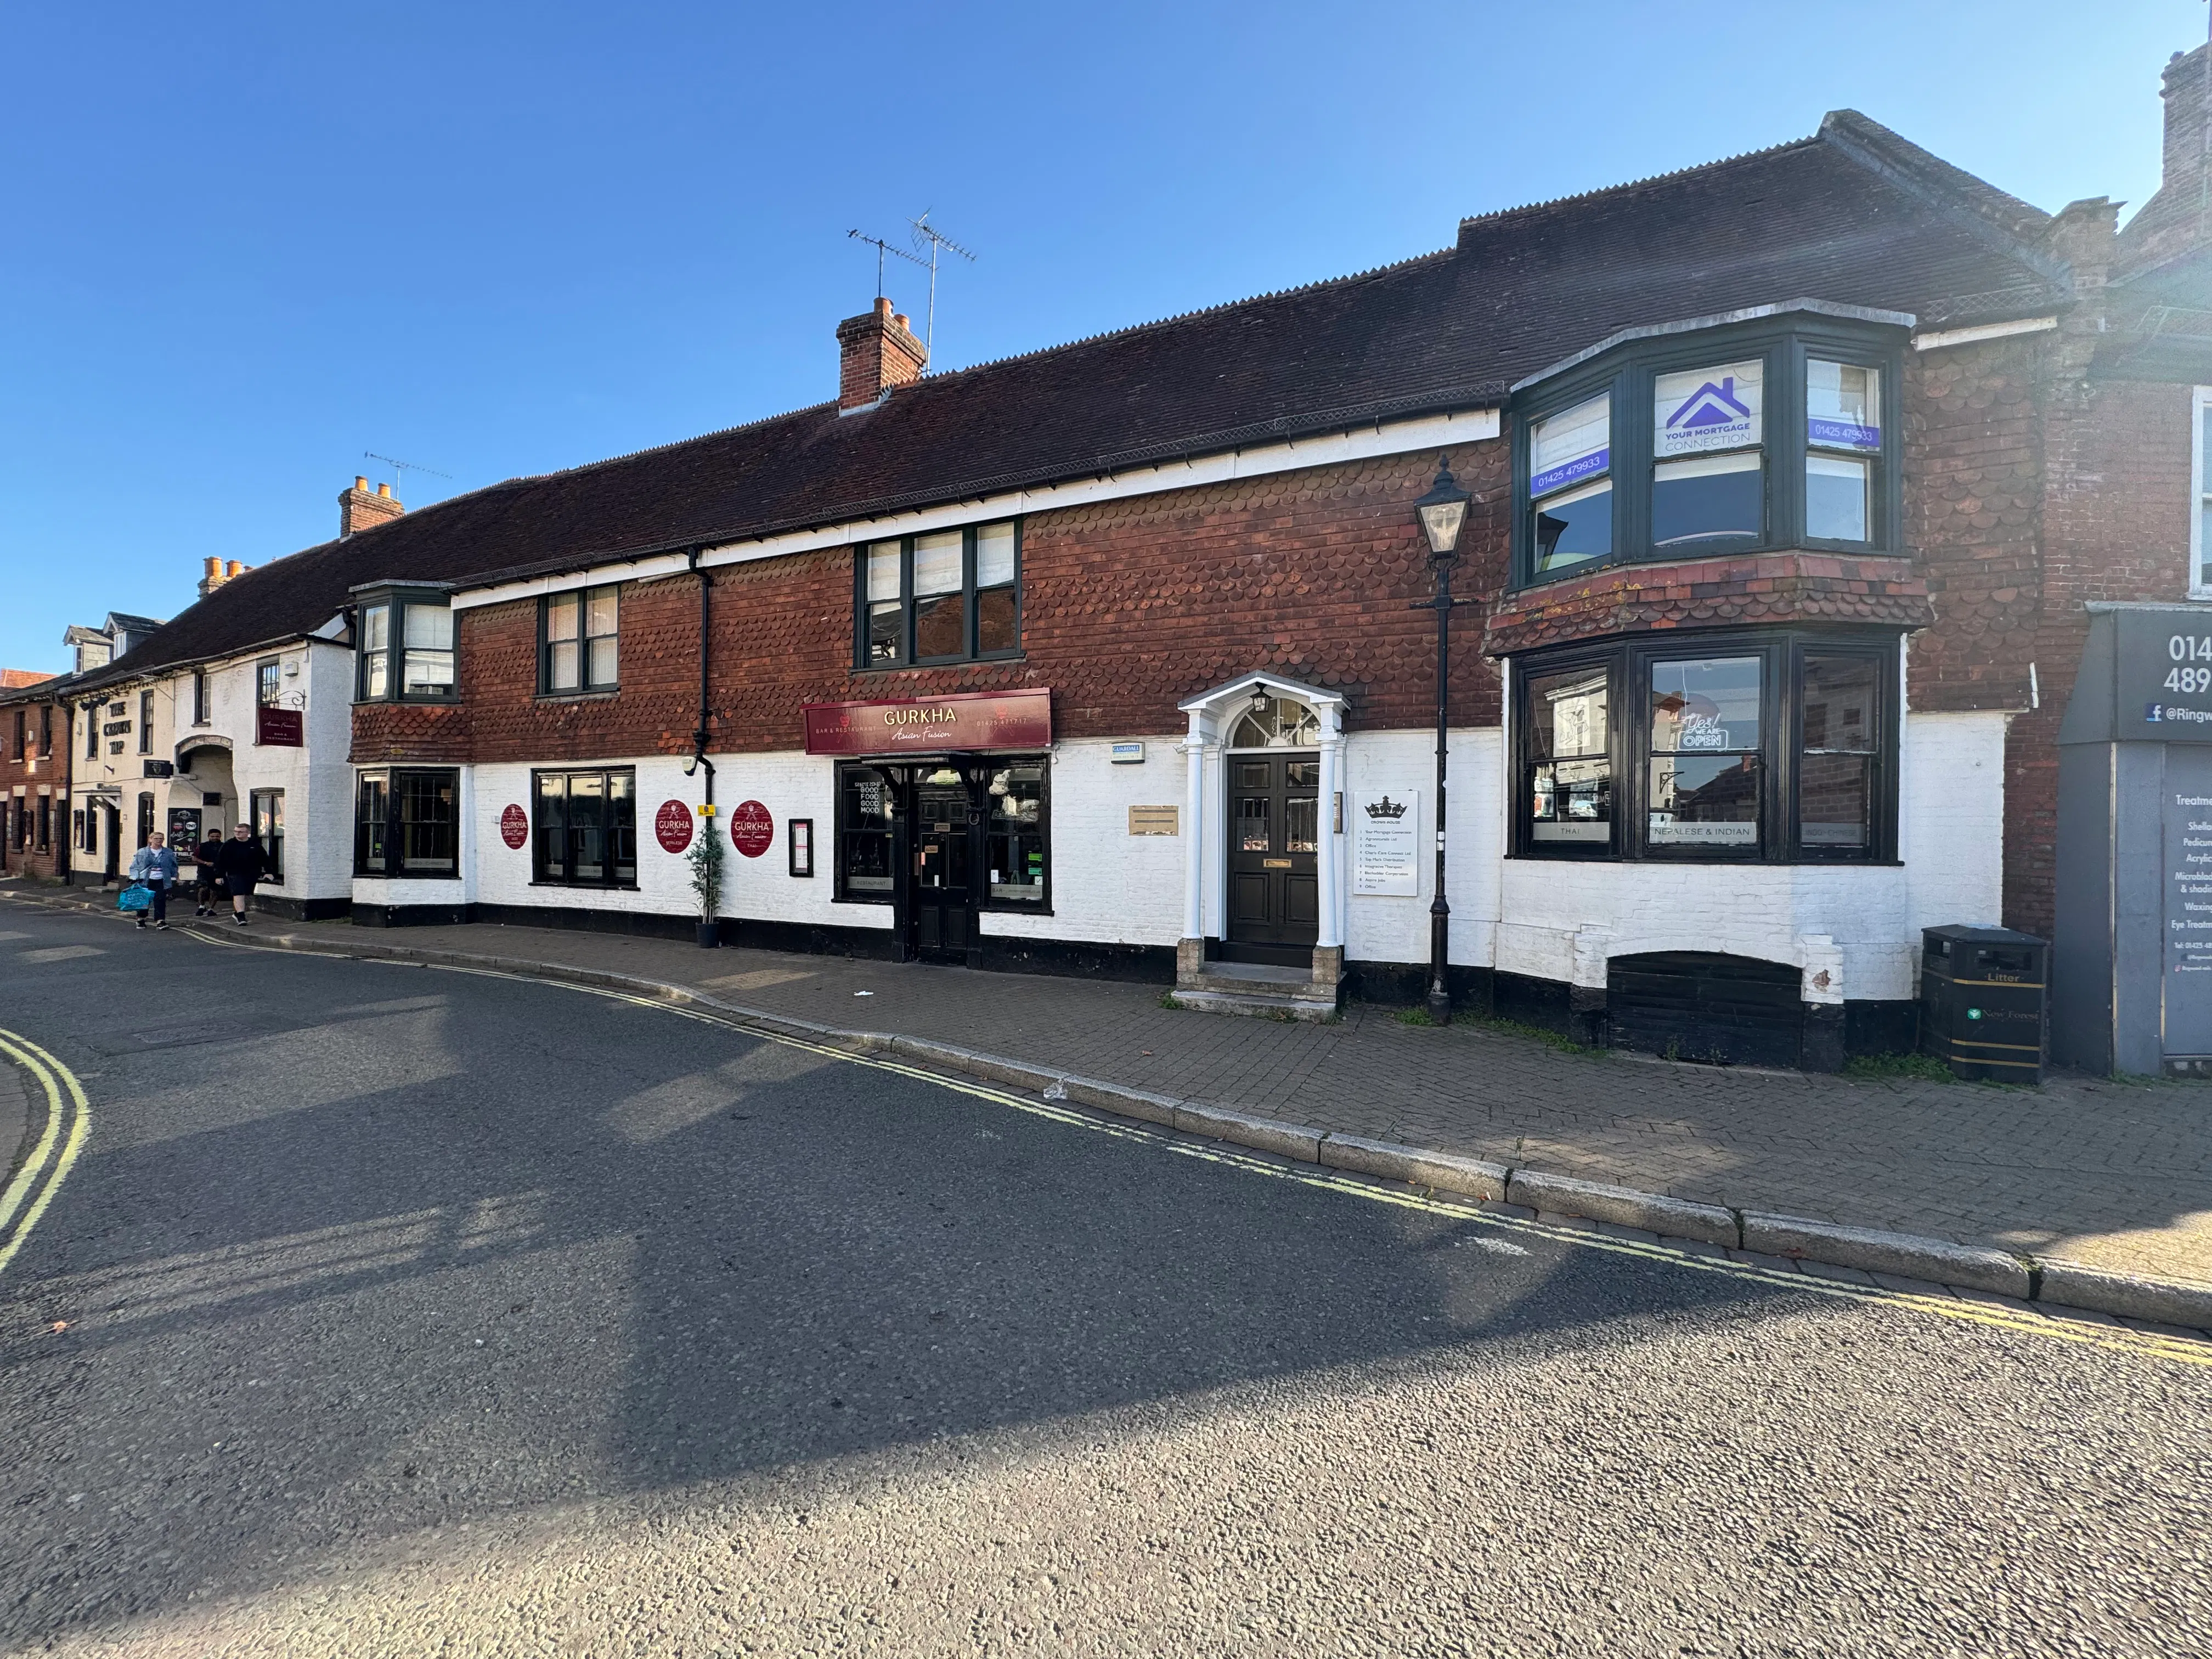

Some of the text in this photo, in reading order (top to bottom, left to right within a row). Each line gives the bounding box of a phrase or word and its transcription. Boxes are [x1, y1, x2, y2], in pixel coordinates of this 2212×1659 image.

[1666, 422, 1750, 440] YOUR MORTGAGE
[1815, 425, 1872, 441] 01425 479933
[1665, 433, 1750, 452] CONNECTION
[1538, 456, 1600, 487] 01425 479933
[2169, 635, 2212, 661] 014
[2164, 668, 2211, 693] 489
[262, 714, 298, 723] GURKHA
[884, 707, 957, 725] GURKHA
[2166, 707, 2212, 723] @Ringw
[892, 725, 952, 742] Asian Fusion
[1683, 735, 1722, 747] OPEN
[502, 821, 527, 829] GURKHA
[658, 820, 690, 829] GURKHA
[735, 822, 769, 831] GURKHA
[2183, 837, 2212, 847] Pedicur
[2180, 884, 2187, 893] &
[2171, 919, 2185, 931] Eye
[1988, 973, 2020, 982] Litter
[1982, 1009, 2039, 1019] New Forest
